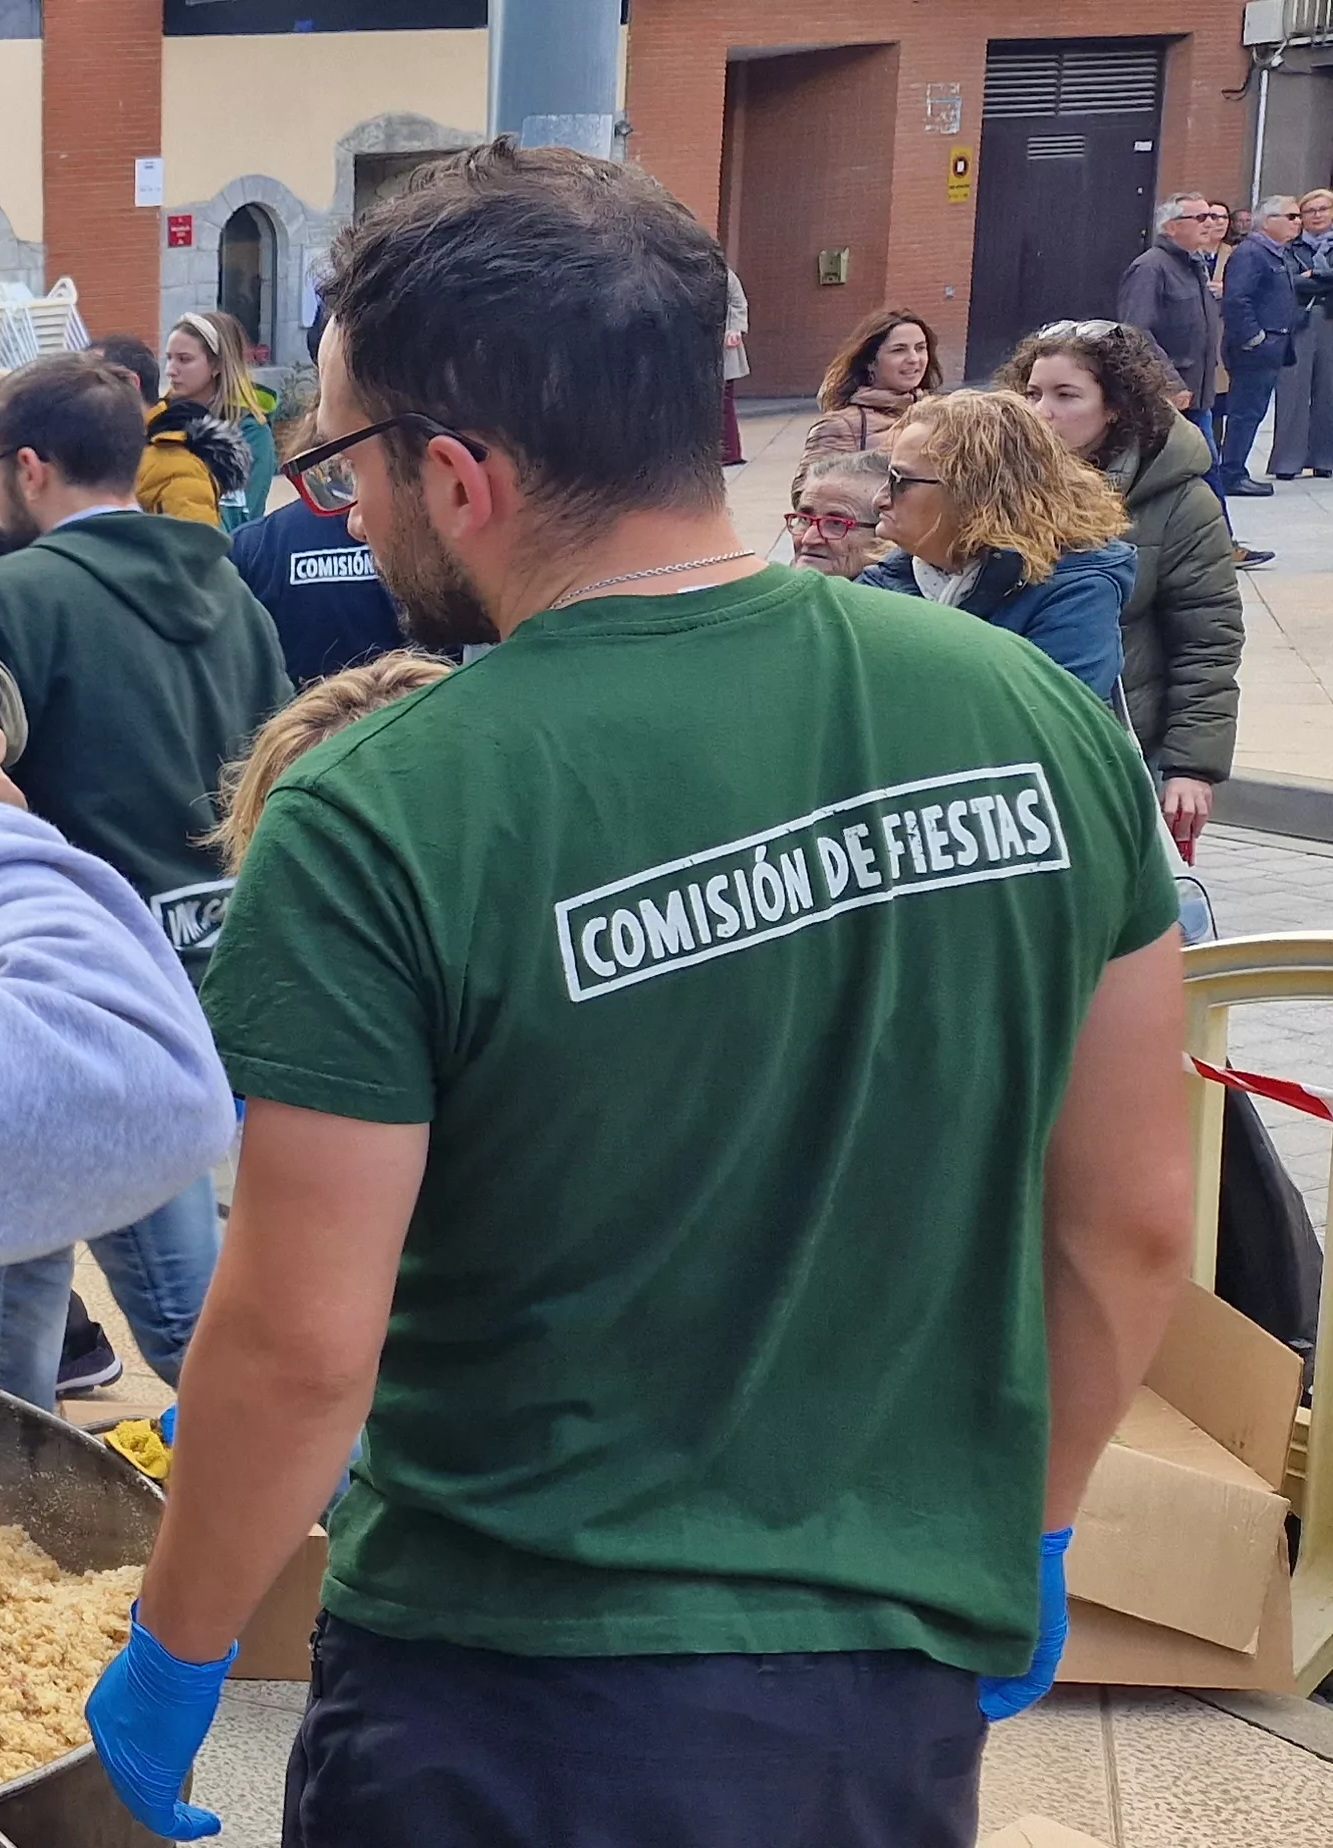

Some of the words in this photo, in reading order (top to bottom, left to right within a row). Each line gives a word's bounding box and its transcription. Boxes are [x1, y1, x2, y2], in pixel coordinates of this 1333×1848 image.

[296, 550, 374, 579] COMISIÓN
[582, 845, 813, 978] COMISIÓN
[816, 823, 883, 899] DE
[881, 788, 1052, 880] FIESTAS
